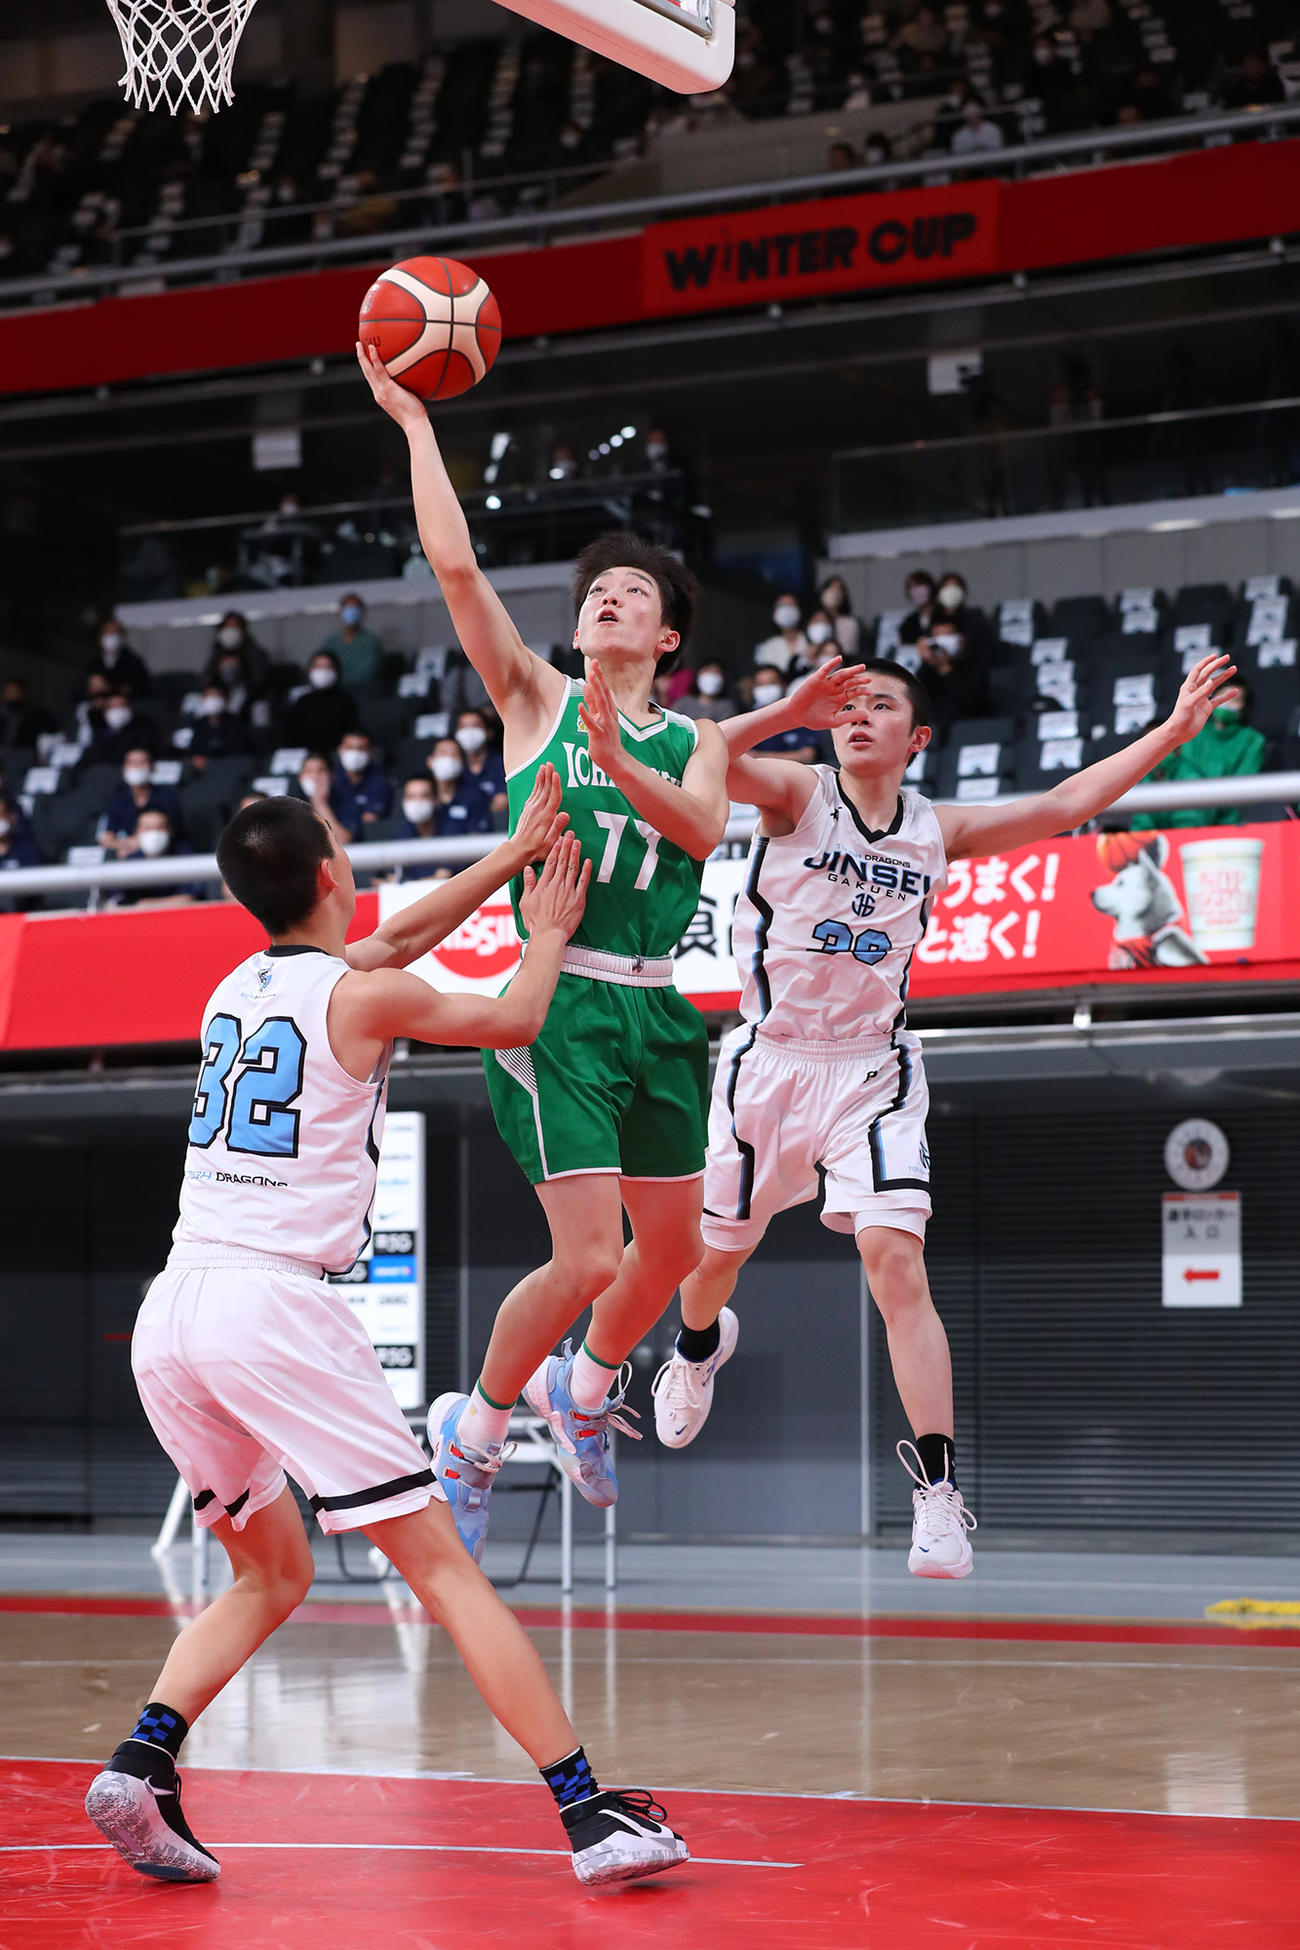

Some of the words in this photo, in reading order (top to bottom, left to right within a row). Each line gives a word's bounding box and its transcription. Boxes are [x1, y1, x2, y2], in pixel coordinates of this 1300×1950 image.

[664, 226, 859, 292] WINTER
[868, 212, 977, 264] CUP
[592, 810, 662, 891] 77
[803, 851, 932, 896] JINSEI
[864, 854, 911, 869] DRAGONS
[827, 873, 907, 901] GAKUEN
[437, 911, 516, 957] ISSI
[673, 893, 738, 960] 食
[188, 1012, 308, 1159] 32
